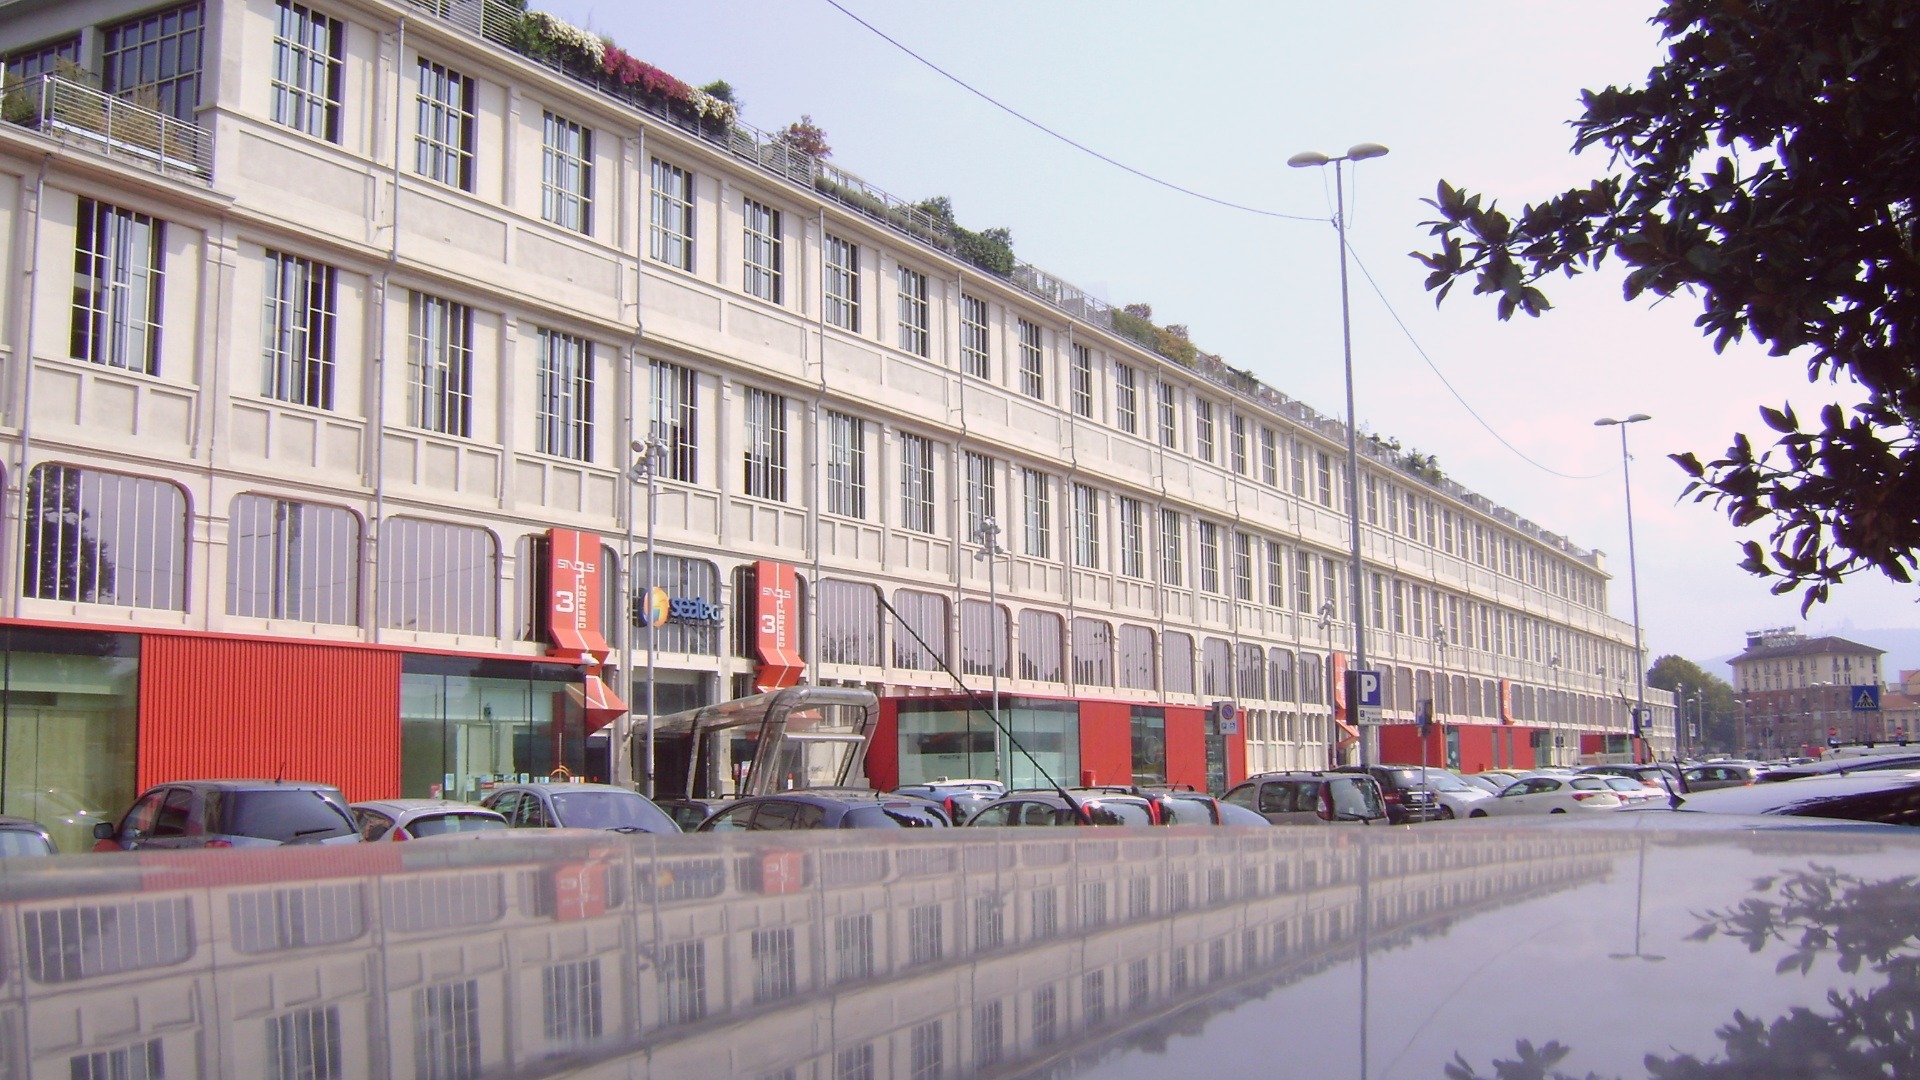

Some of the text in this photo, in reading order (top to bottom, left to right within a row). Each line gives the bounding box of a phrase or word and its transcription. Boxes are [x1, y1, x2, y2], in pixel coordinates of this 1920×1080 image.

[556, 591, 575, 613] 3
[578, 579, 587, 629] INGRESSO
[761, 614, 776, 634] 3
[1361, 674, 1377, 702] P
[1641, 710, 1651, 727] P
